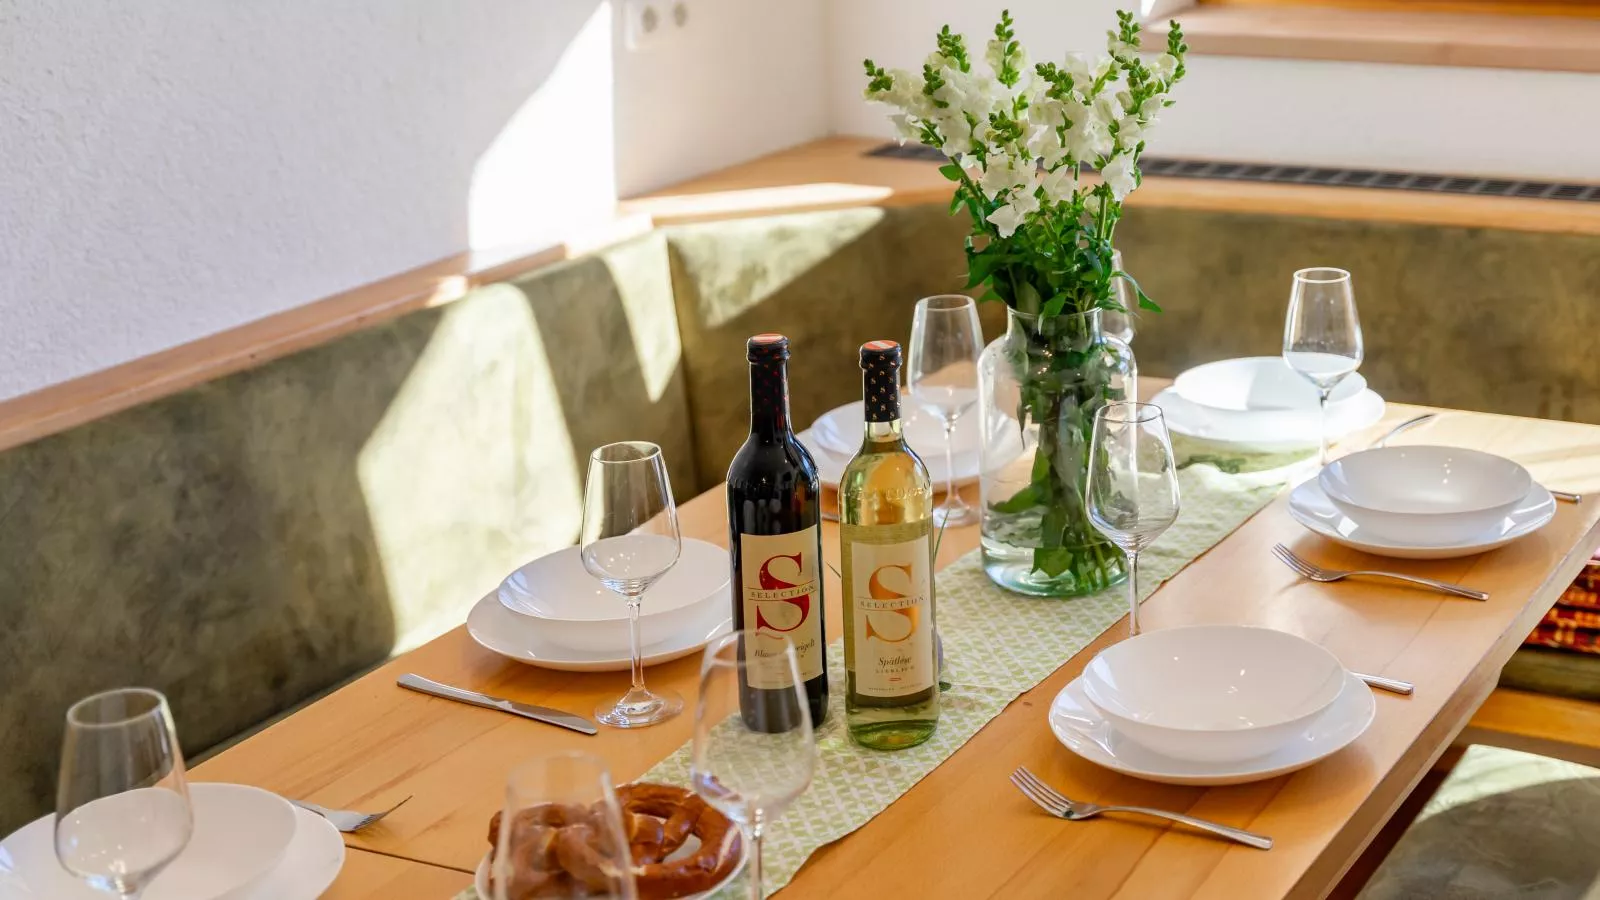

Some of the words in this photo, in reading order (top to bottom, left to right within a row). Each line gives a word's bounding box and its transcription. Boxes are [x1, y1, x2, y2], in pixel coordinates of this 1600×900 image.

[751, 584, 816, 599] SELECTION
[756, 552, 810, 634] S
[859, 596, 926, 609] SELECTION
[866, 564, 922, 643] S
